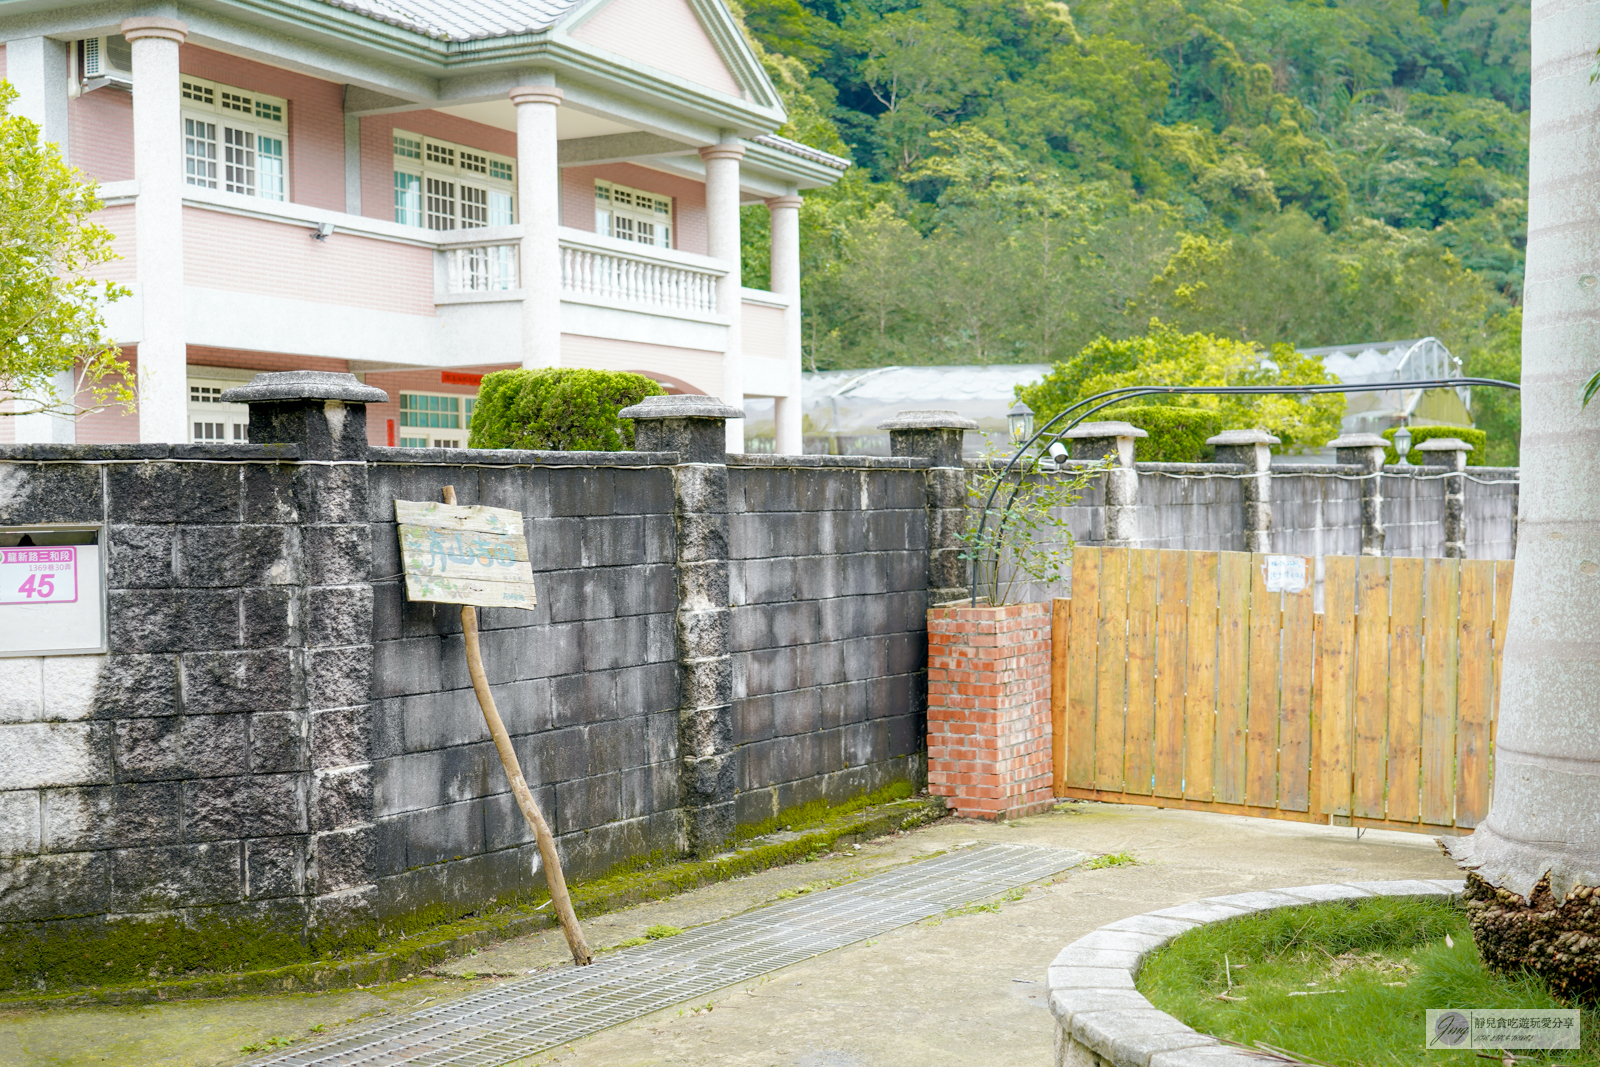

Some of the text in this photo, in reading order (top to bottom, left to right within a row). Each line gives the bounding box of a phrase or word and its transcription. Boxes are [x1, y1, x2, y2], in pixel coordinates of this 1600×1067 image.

[7, 551, 70, 563] 龍新路三和段
[28, 563, 72, 572] 1369巷30弄
[18, 573, 55, 599] 45
